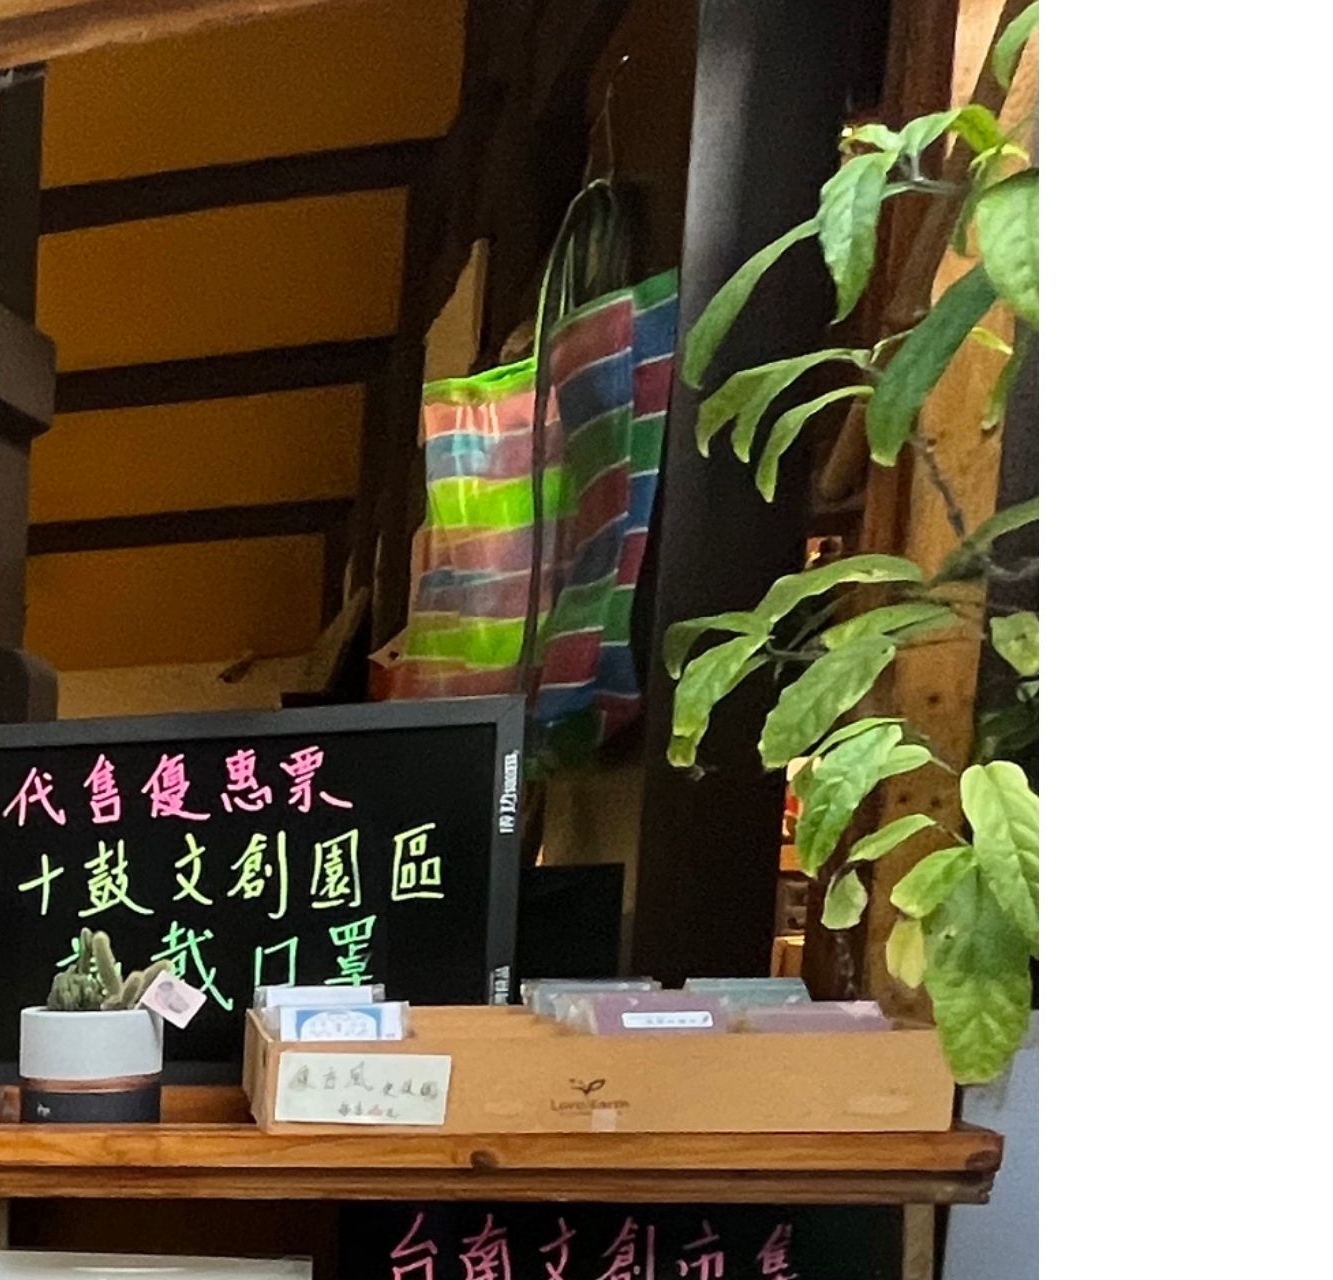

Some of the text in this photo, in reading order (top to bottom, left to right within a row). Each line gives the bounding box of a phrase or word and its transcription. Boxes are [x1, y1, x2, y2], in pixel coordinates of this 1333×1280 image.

[3, 746, 352, 827] 代售優惠票
[19, 822, 444, 918] 十鼓文創園區
